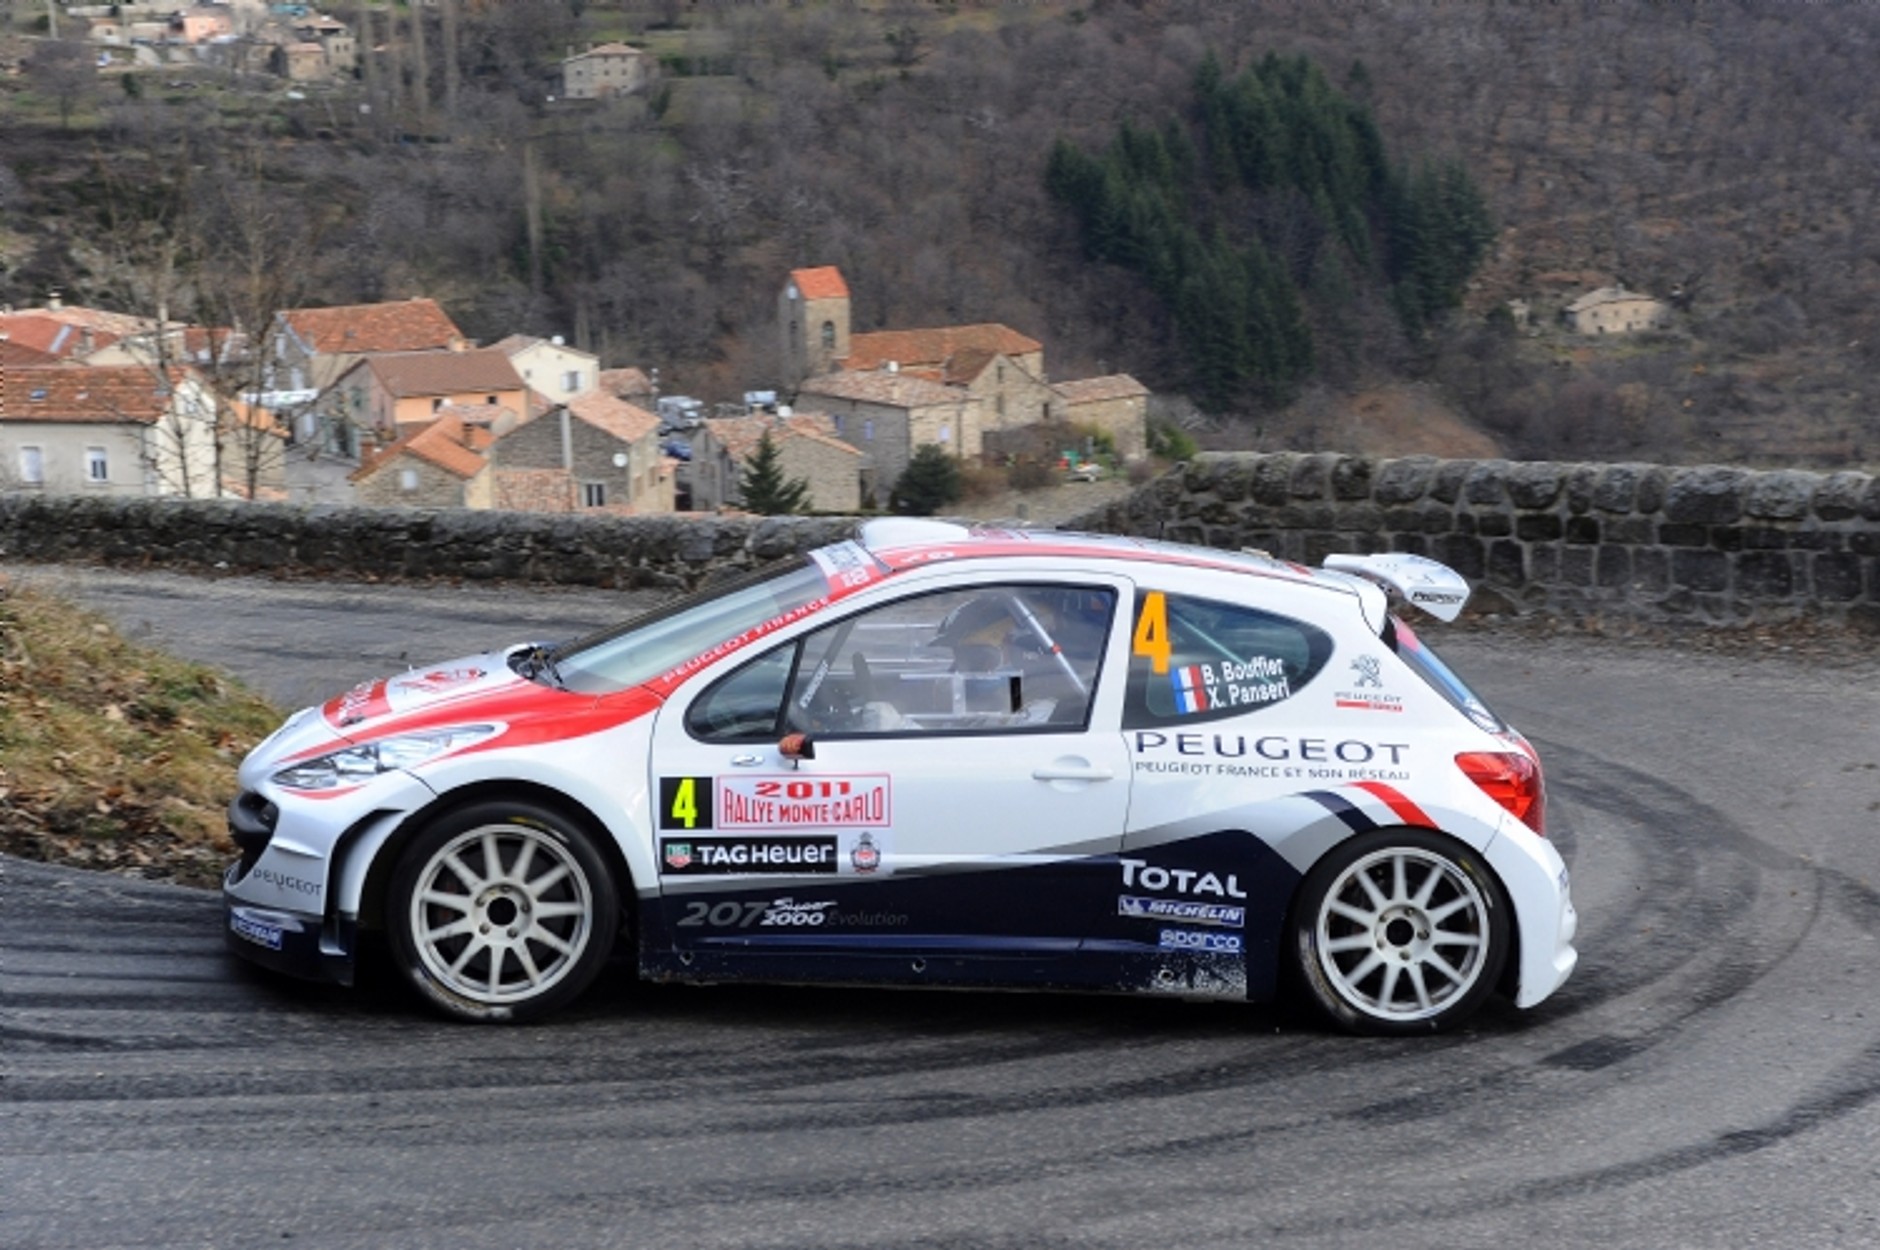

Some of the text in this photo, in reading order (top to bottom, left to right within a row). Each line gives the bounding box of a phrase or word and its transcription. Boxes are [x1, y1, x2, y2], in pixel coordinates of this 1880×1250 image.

[1133, 591, 1171, 675] 4
[1201, 664, 1220, 685] B.
[1206, 686, 1227, 709] X.
[1135, 731, 1410, 765] PEUGEOT
[1135, 761, 1211, 775] PEUGEOT
[1216, 764, 1279, 778] FRANCE
[1308, 767, 1343, 780] SON
[755, 781, 850, 799] 2011
[672, 778, 697, 828] 4
[724, 787, 774, 823] RALLYE
[677, 902, 770, 927] 207
